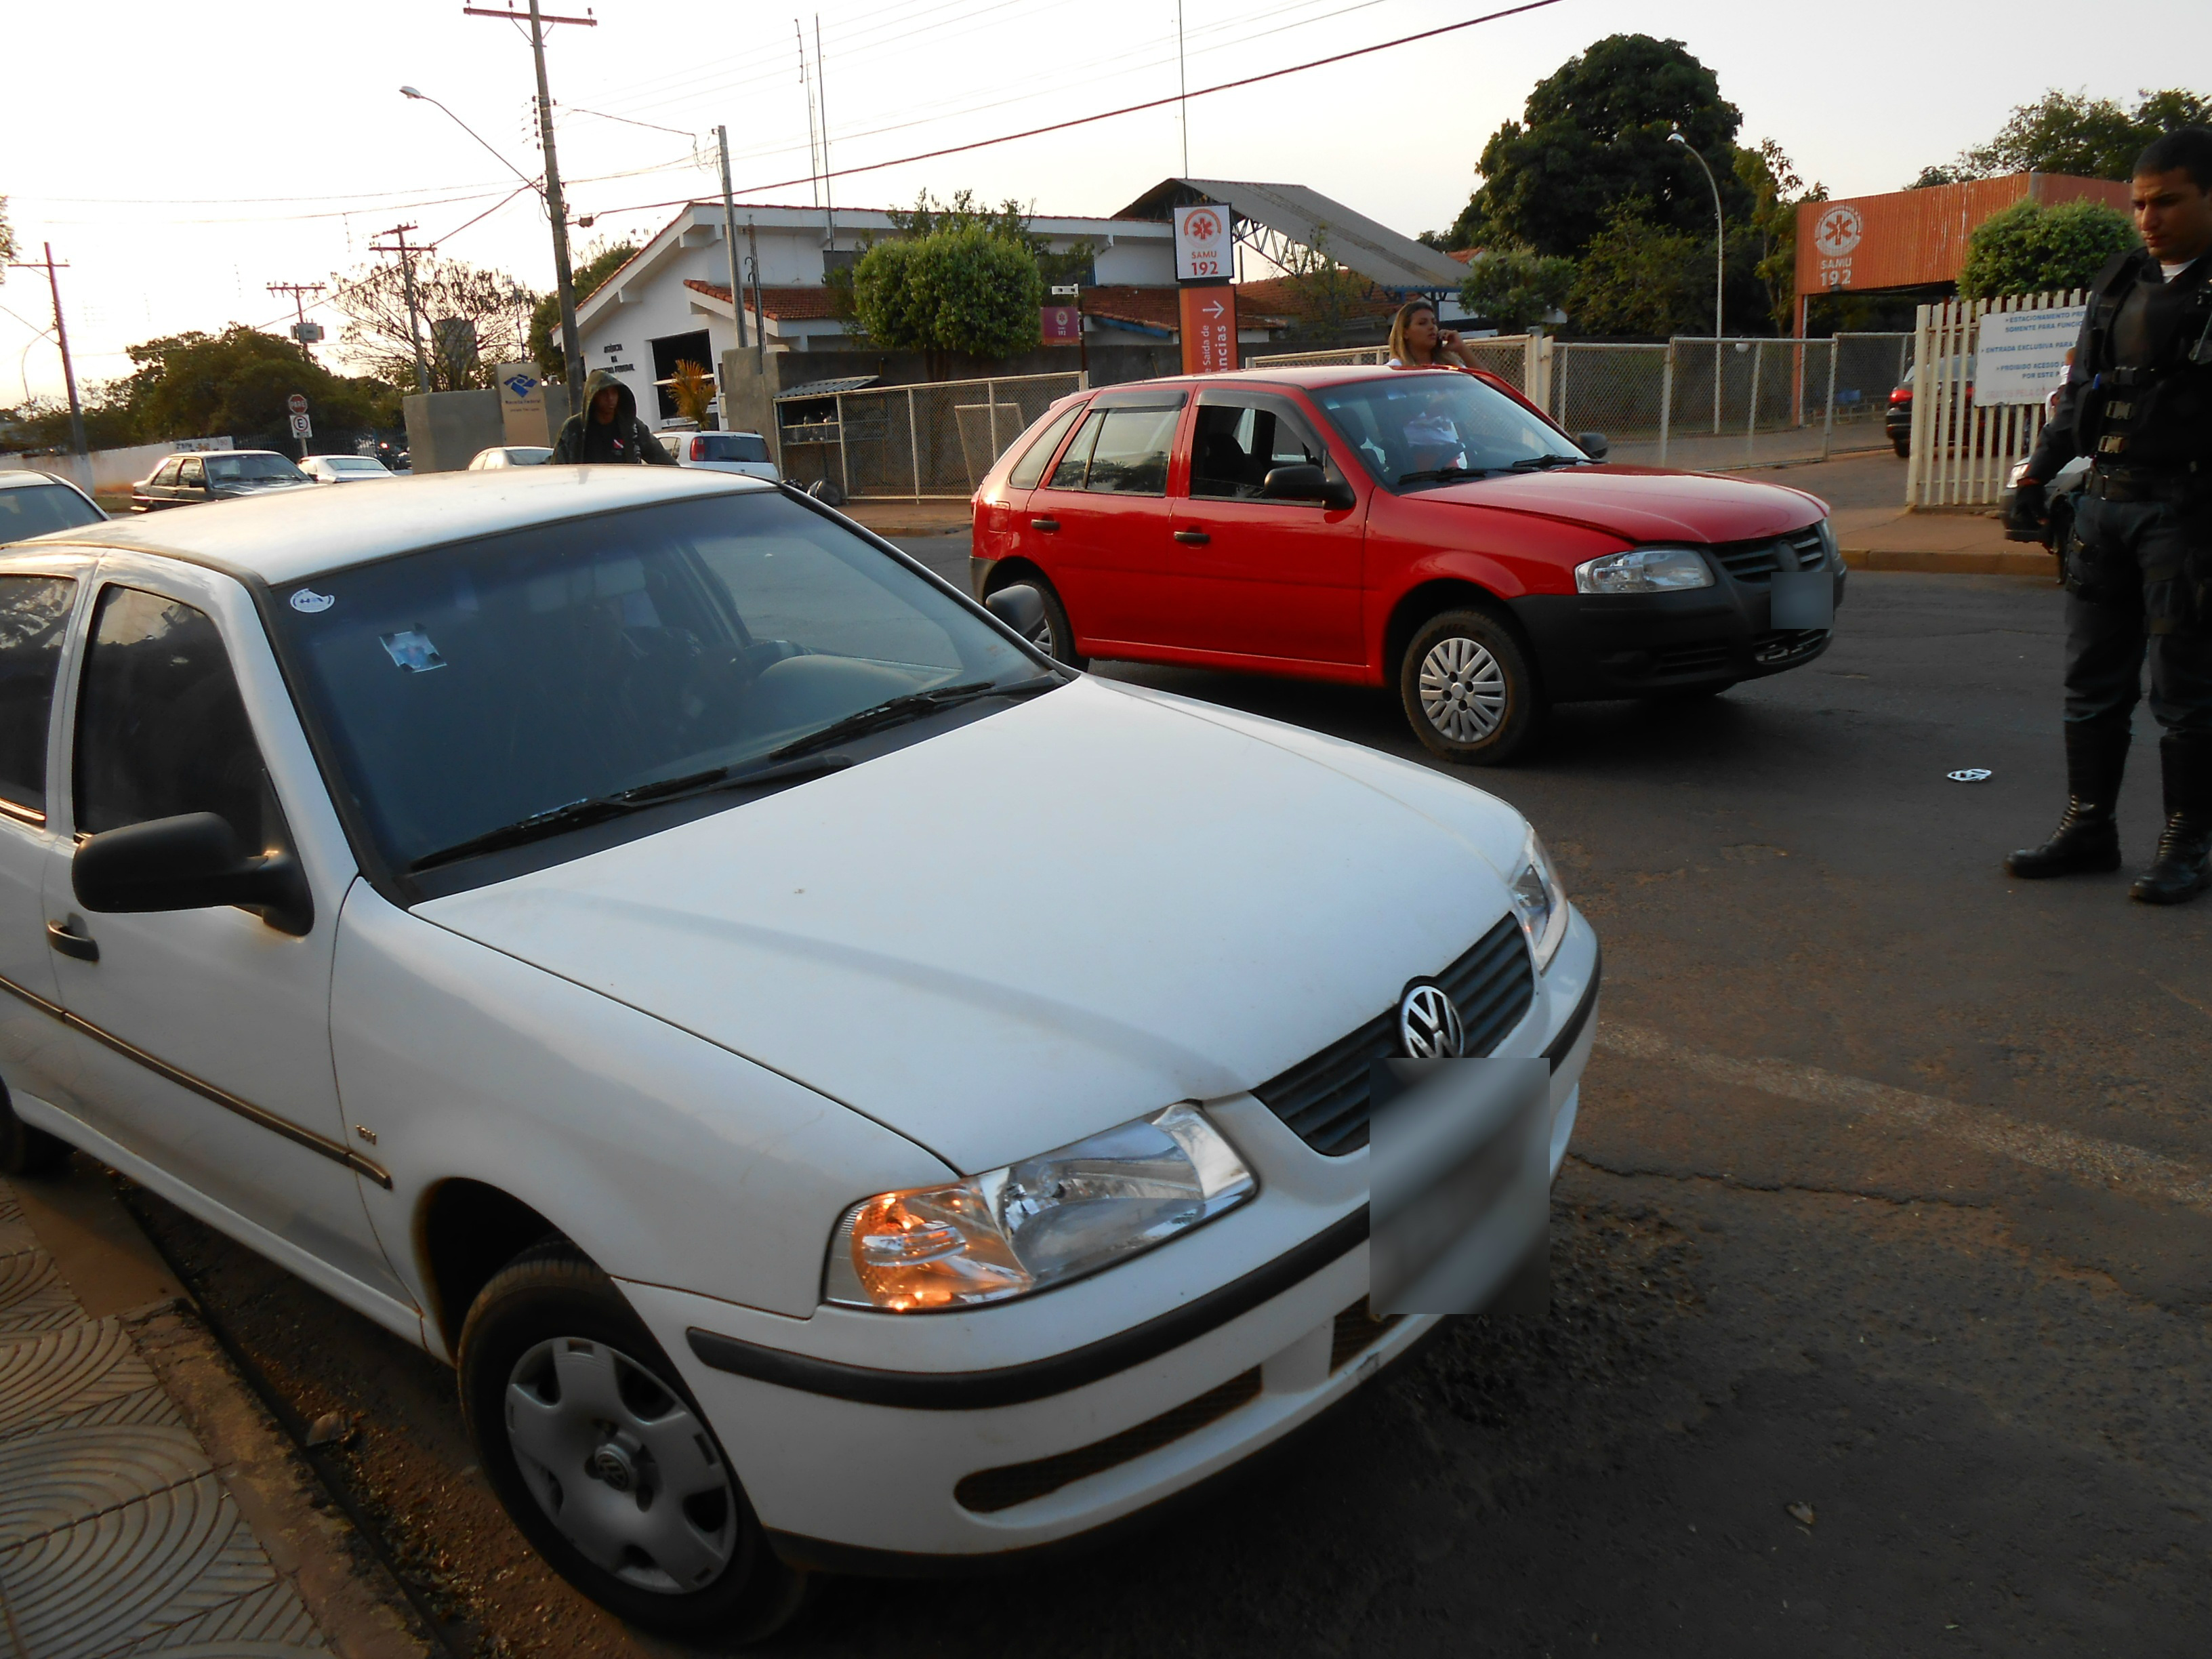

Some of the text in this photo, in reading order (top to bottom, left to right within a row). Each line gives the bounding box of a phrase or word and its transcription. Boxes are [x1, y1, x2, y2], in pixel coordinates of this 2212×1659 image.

[1191, 251, 1217, 260] SAMU
[1191, 261, 1218, 276] 192
[1821, 257, 1852, 270] SAMU
[1821, 269, 1851, 286] 192
[2009, 312, 2070, 323] ESTACIONAMENTO
[1201, 325, 1210, 337] de
[2005, 325, 2036, 333] SOMENTE
[2038, 323, 2055, 331] PARA
[2018, 342, 2053, 351] EXCLUSIVA
[298, 419, 304, 428] E
